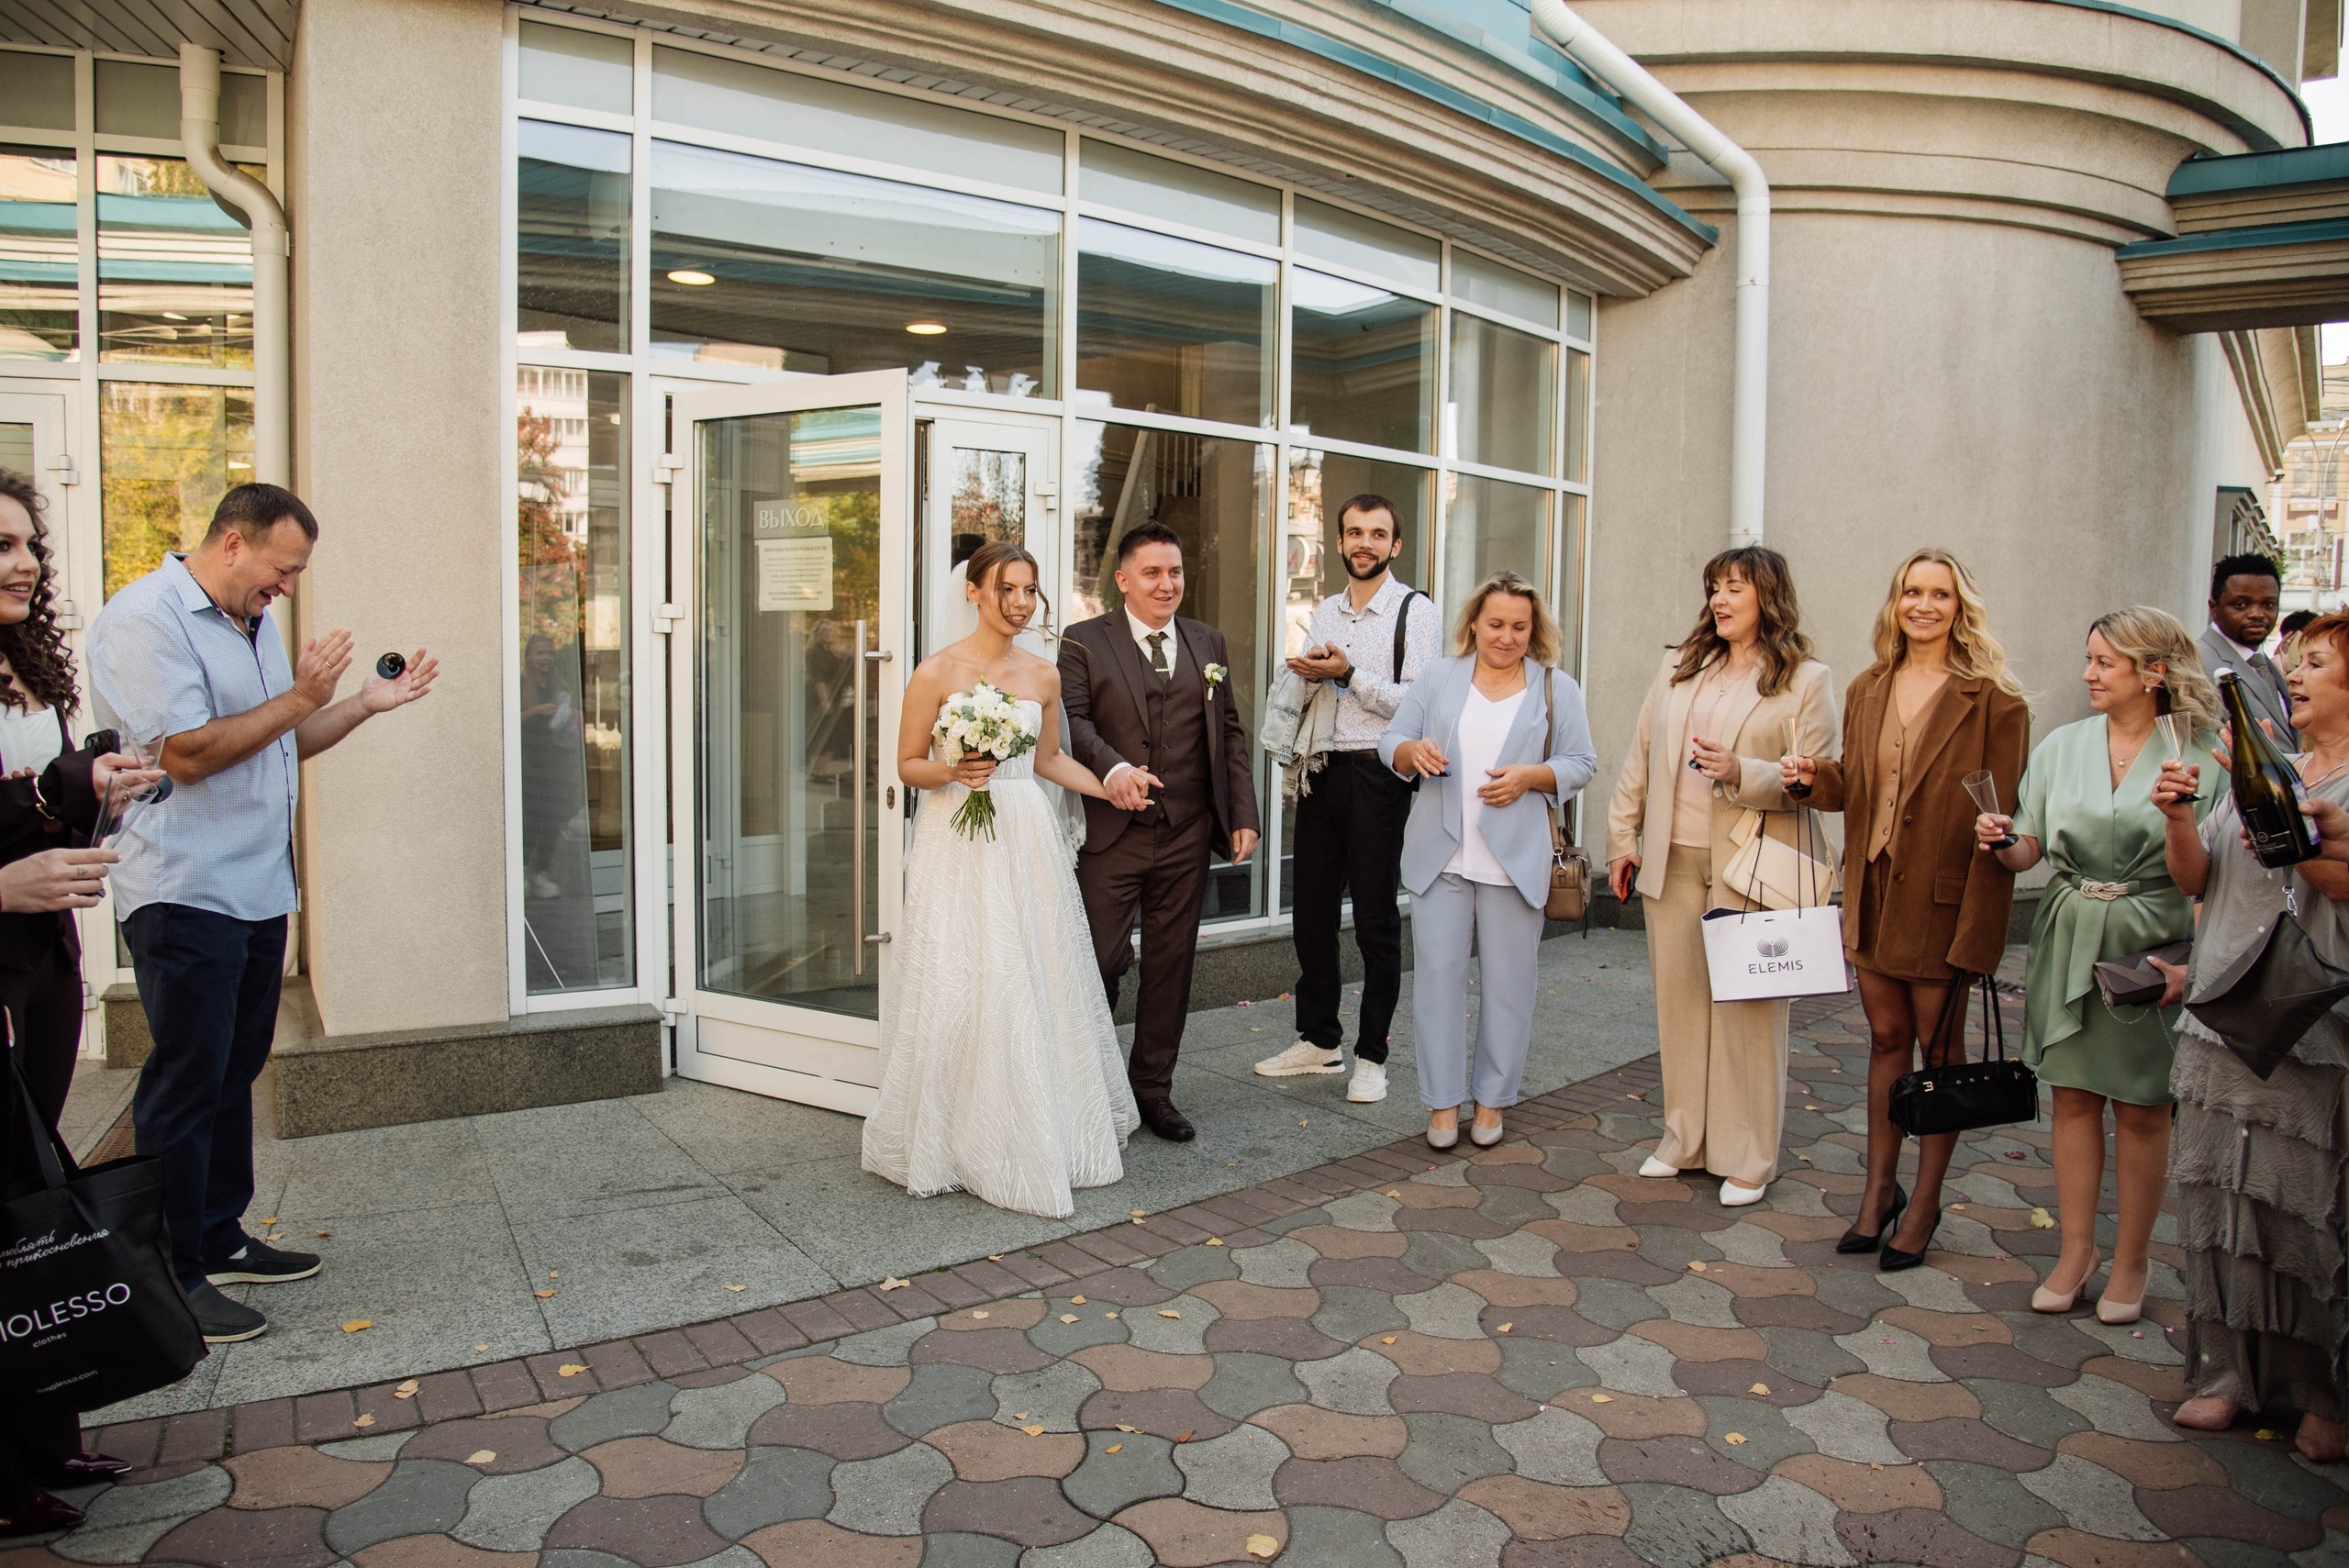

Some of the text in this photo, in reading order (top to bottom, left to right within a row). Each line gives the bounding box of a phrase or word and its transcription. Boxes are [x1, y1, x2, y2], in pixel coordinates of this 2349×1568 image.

[759, 507, 825, 529] ВЫХОД
[1748, 960, 1804, 974] ELEMIS
[6, 1229, 110, 1268] прикосновения
[32, 1331, 67, 1348] clothes
